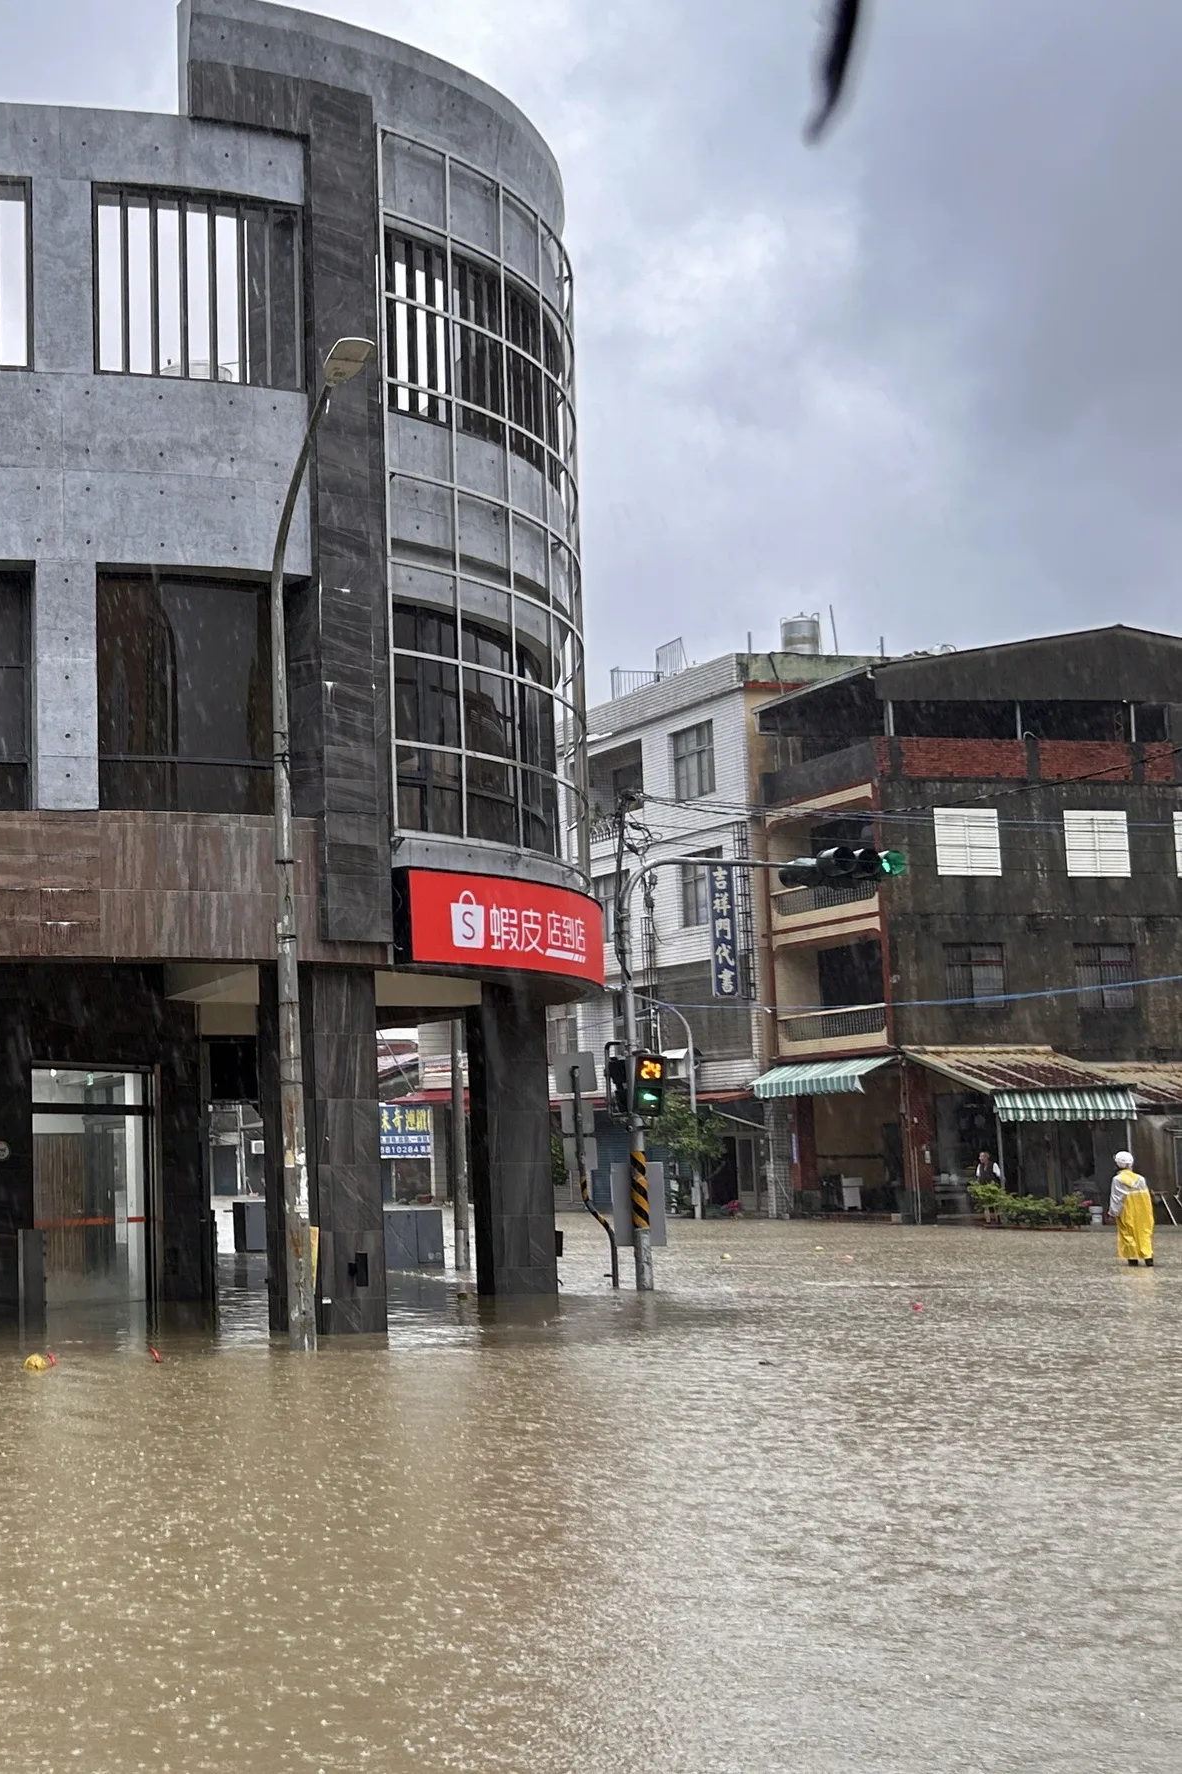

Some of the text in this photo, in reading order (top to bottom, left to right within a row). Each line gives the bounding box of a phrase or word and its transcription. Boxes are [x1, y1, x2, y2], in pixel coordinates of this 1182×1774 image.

[461, 911, 476, 941] S
[712, 865, 735, 994] 吉祥門代書
